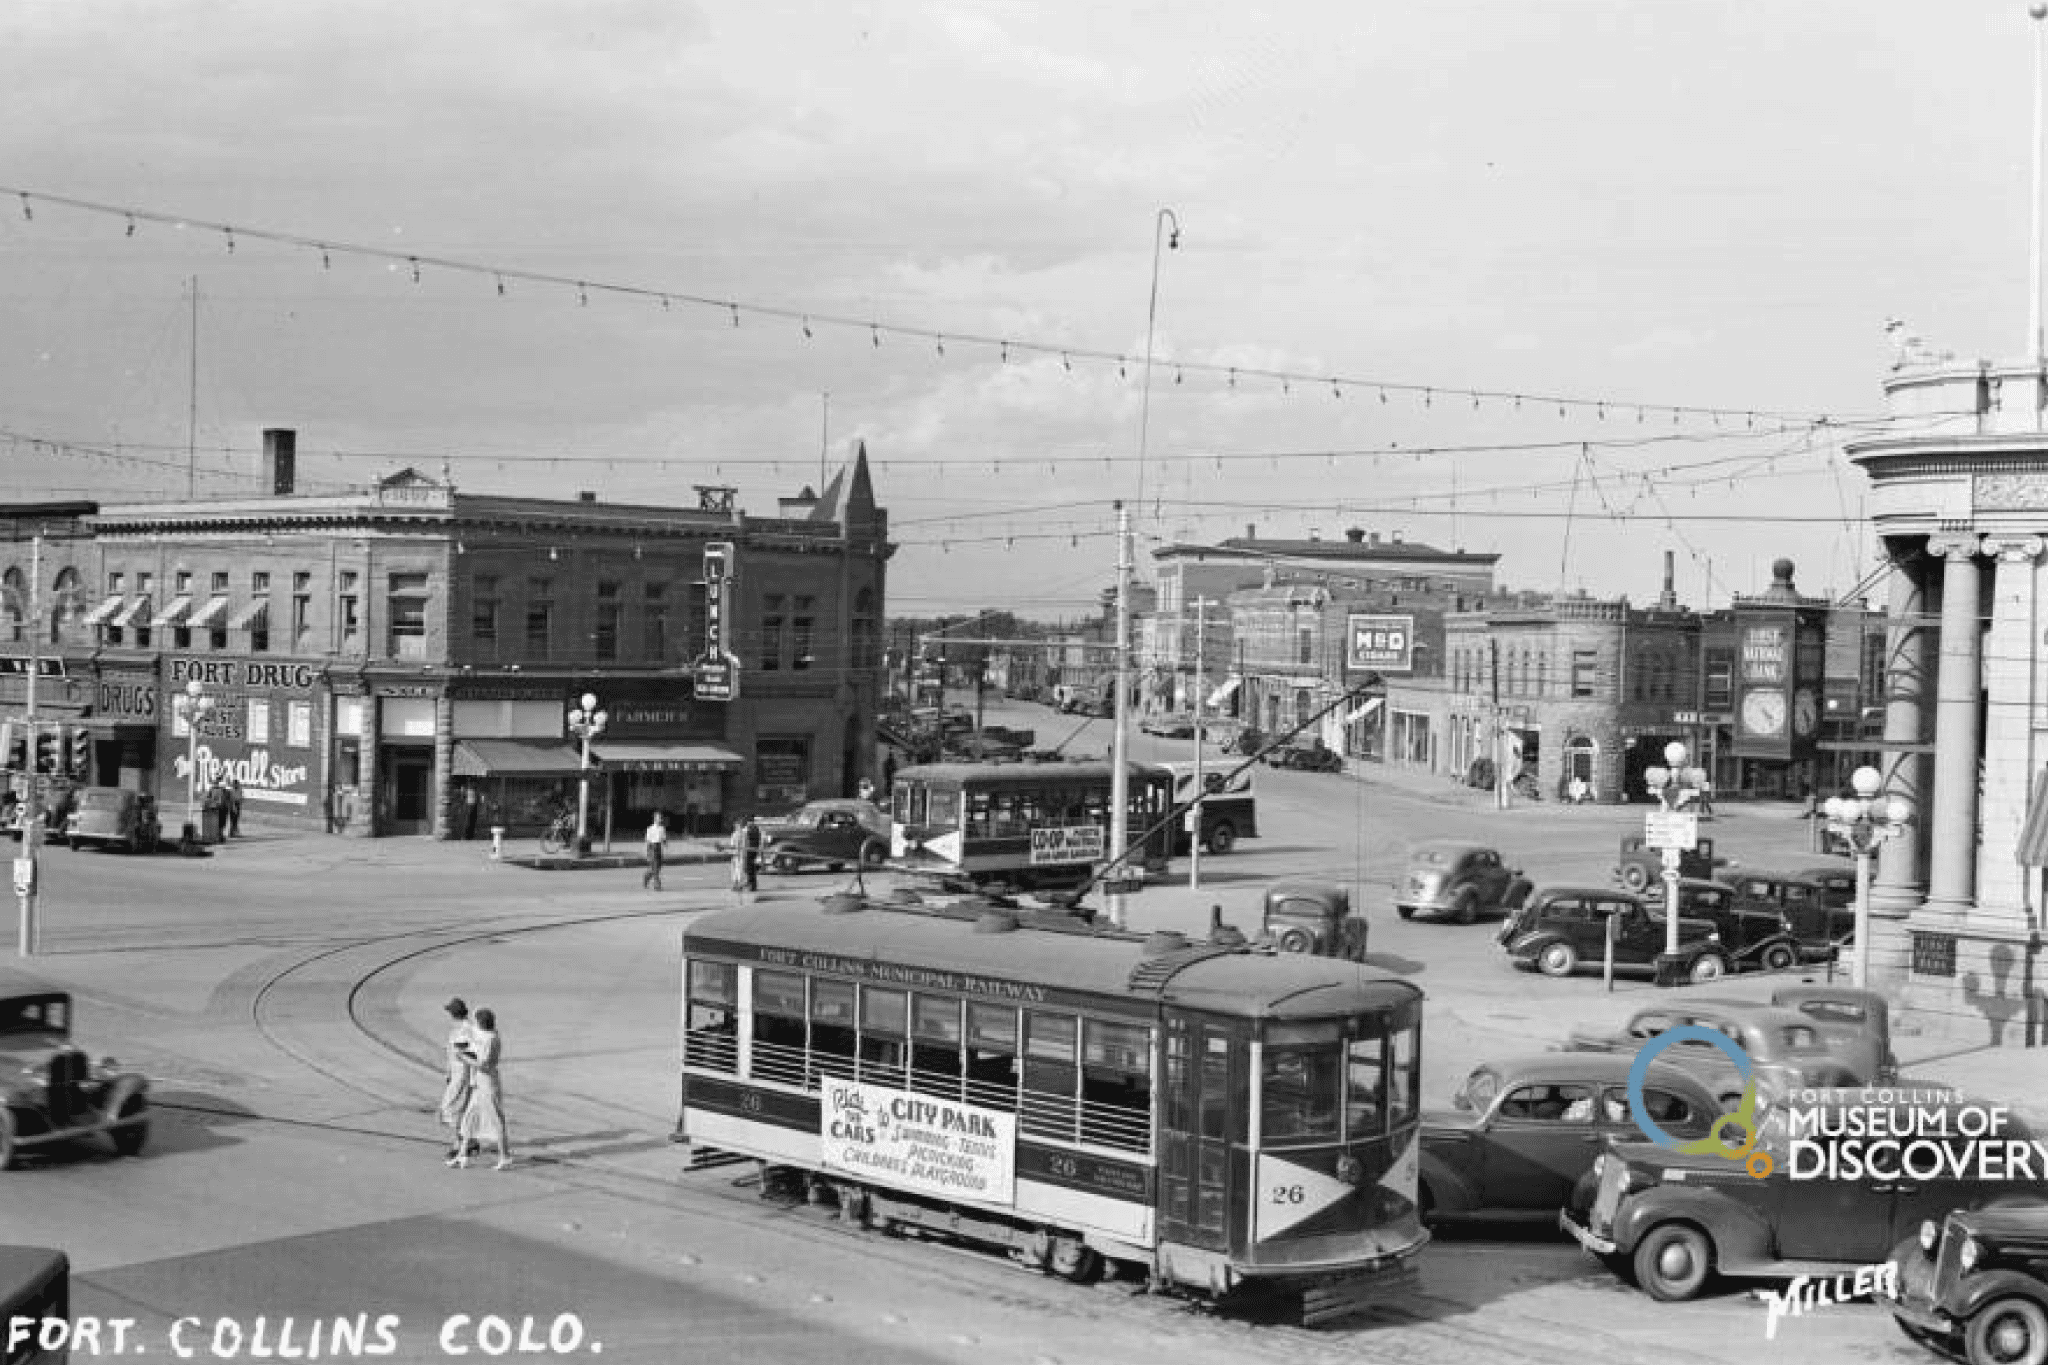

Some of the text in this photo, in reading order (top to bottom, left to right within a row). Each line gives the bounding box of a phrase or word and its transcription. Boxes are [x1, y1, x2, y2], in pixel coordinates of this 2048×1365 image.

[172, 659, 313, 688] FORT DRUG
[101, 683, 153, 714] DRUGS
[198, 745, 268, 793] Rexall
[270, 763, 307, 788] Store
[802, 954, 865, 975] COLLINS
[872, 963, 953, 988] MUNICIPAL
[965, 975, 1044, 1001] RAILWAY
[830, 1119, 875, 1143] CARS
[891, 1098, 939, 1125] CITY
[942, 1107, 997, 1139] PARK
[910, 1162, 988, 1191] PLAYGROUND
[1273, 1184, 1305, 1205] 26
